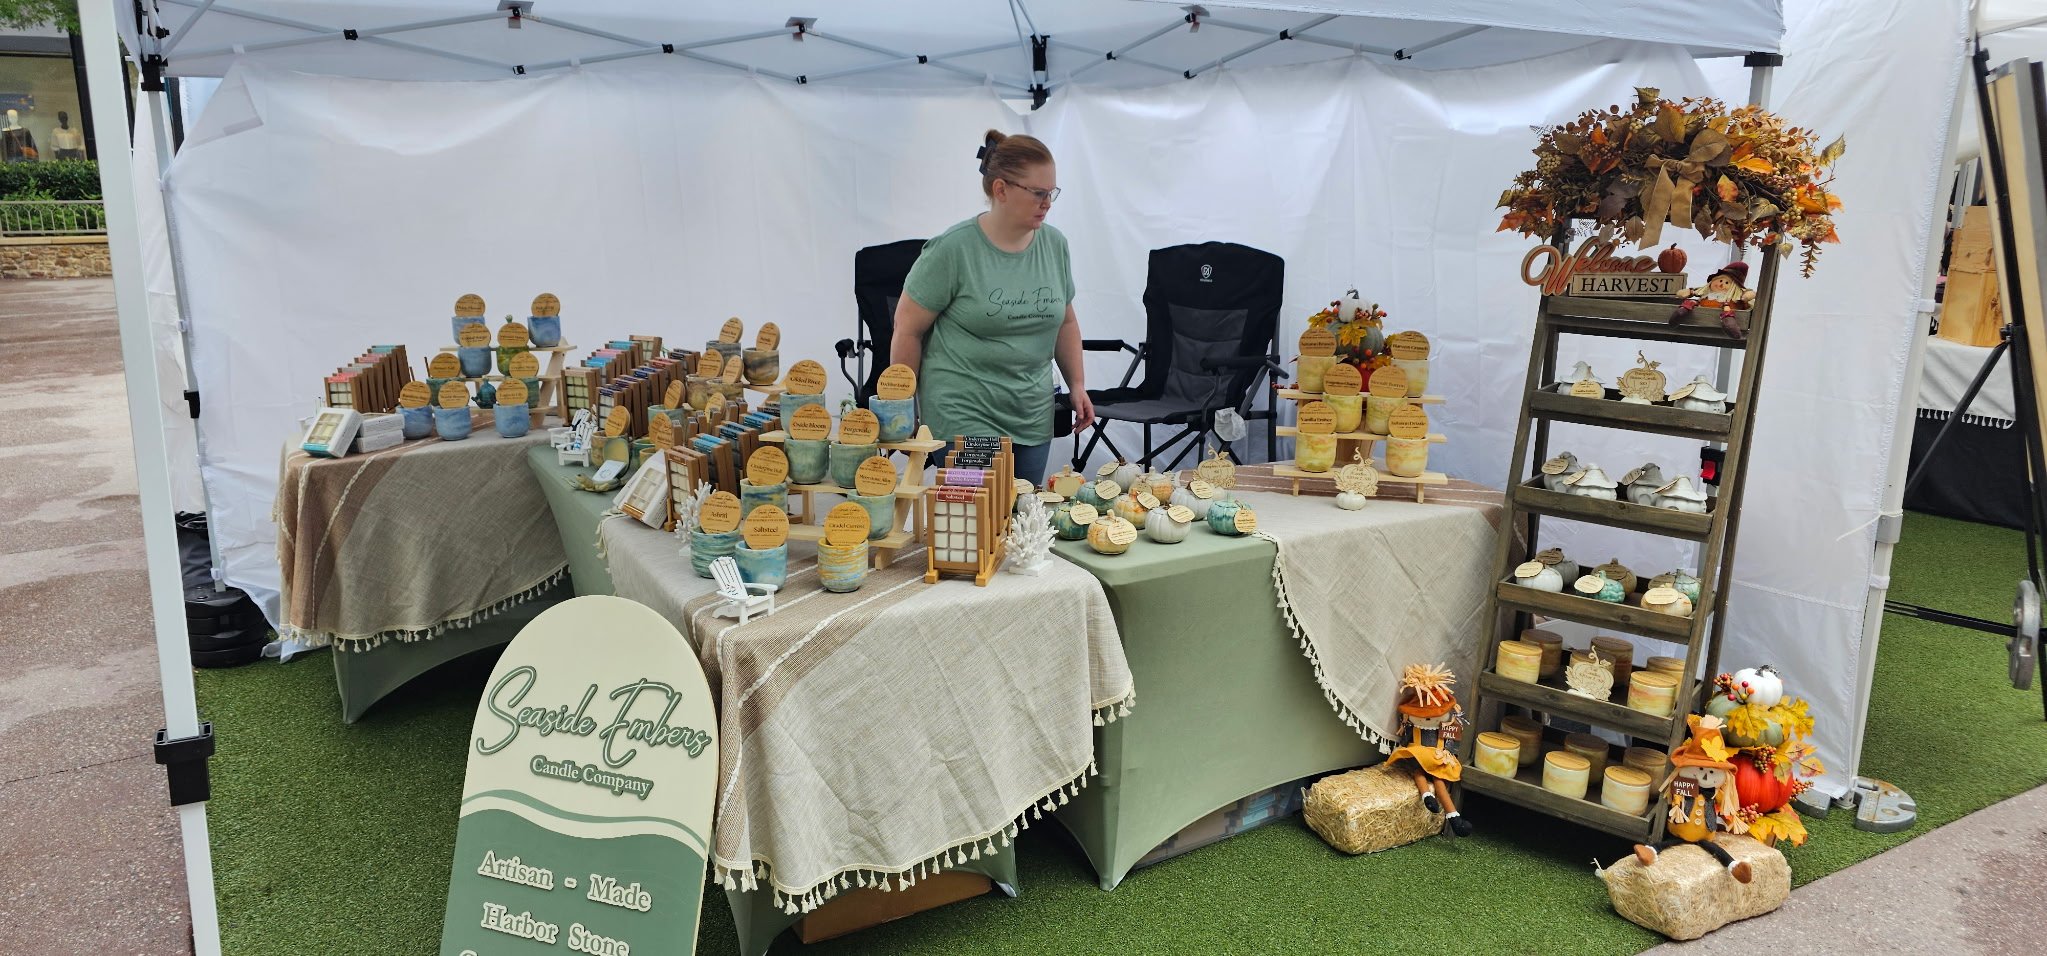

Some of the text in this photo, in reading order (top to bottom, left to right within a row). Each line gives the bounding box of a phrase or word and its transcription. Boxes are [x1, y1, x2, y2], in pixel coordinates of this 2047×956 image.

[1521, 236, 1658, 296] Welcome
[1581, 277, 1674, 293] HARVEST
[986, 288, 1029, 316] Seaside
[476, 665, 712, 768] Seaside Embers
[531, 755, 652, 799] Candle Company
[1673, 780, 1695, 789] HAPPY
[1676, 788, 1692, 797] FALL
[478, 851, 553, 890] Artisan
[588, 874, 651, 911] Made
[481, 902, 629, 956] Harbor Stone
